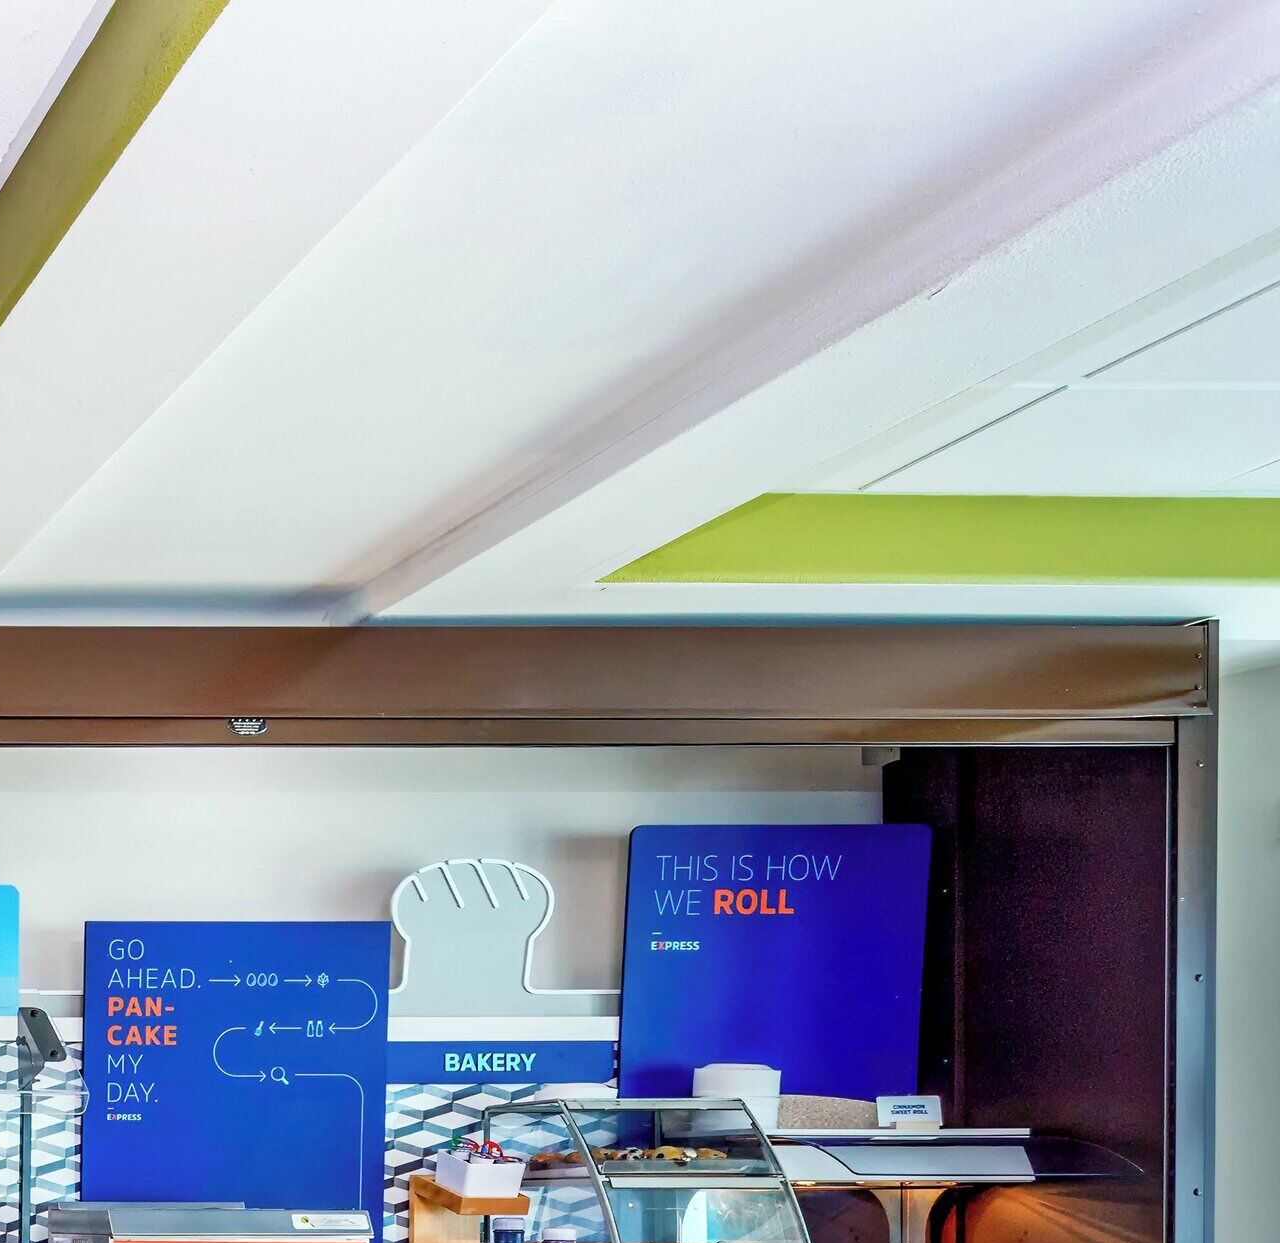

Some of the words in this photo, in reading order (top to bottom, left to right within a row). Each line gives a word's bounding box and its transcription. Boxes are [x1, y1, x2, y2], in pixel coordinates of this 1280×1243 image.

[656, 854, 719, 882] THIS
[731, 854, 755, 882] IS
[766, 854, 843, 881] HOW
[654, 889, 703, 916] WE
[712, 888, 795, 915] ROLL
[108, 939, 145, 961] GO
[650, 941, 700, 951] EXPRESS
[107, 968, 202, 989] AHEAD.
[108, 996, 175, 1017] PAN-
[107, 1025, 178, 1046] CAKE
[107, 1054, 144, 1074] MY
[444, 1052, 537, 1073] BAKERY
[107, 1082, 159, 1103] DAY.
[107, 1113, 142, 1121] EXPRESS
